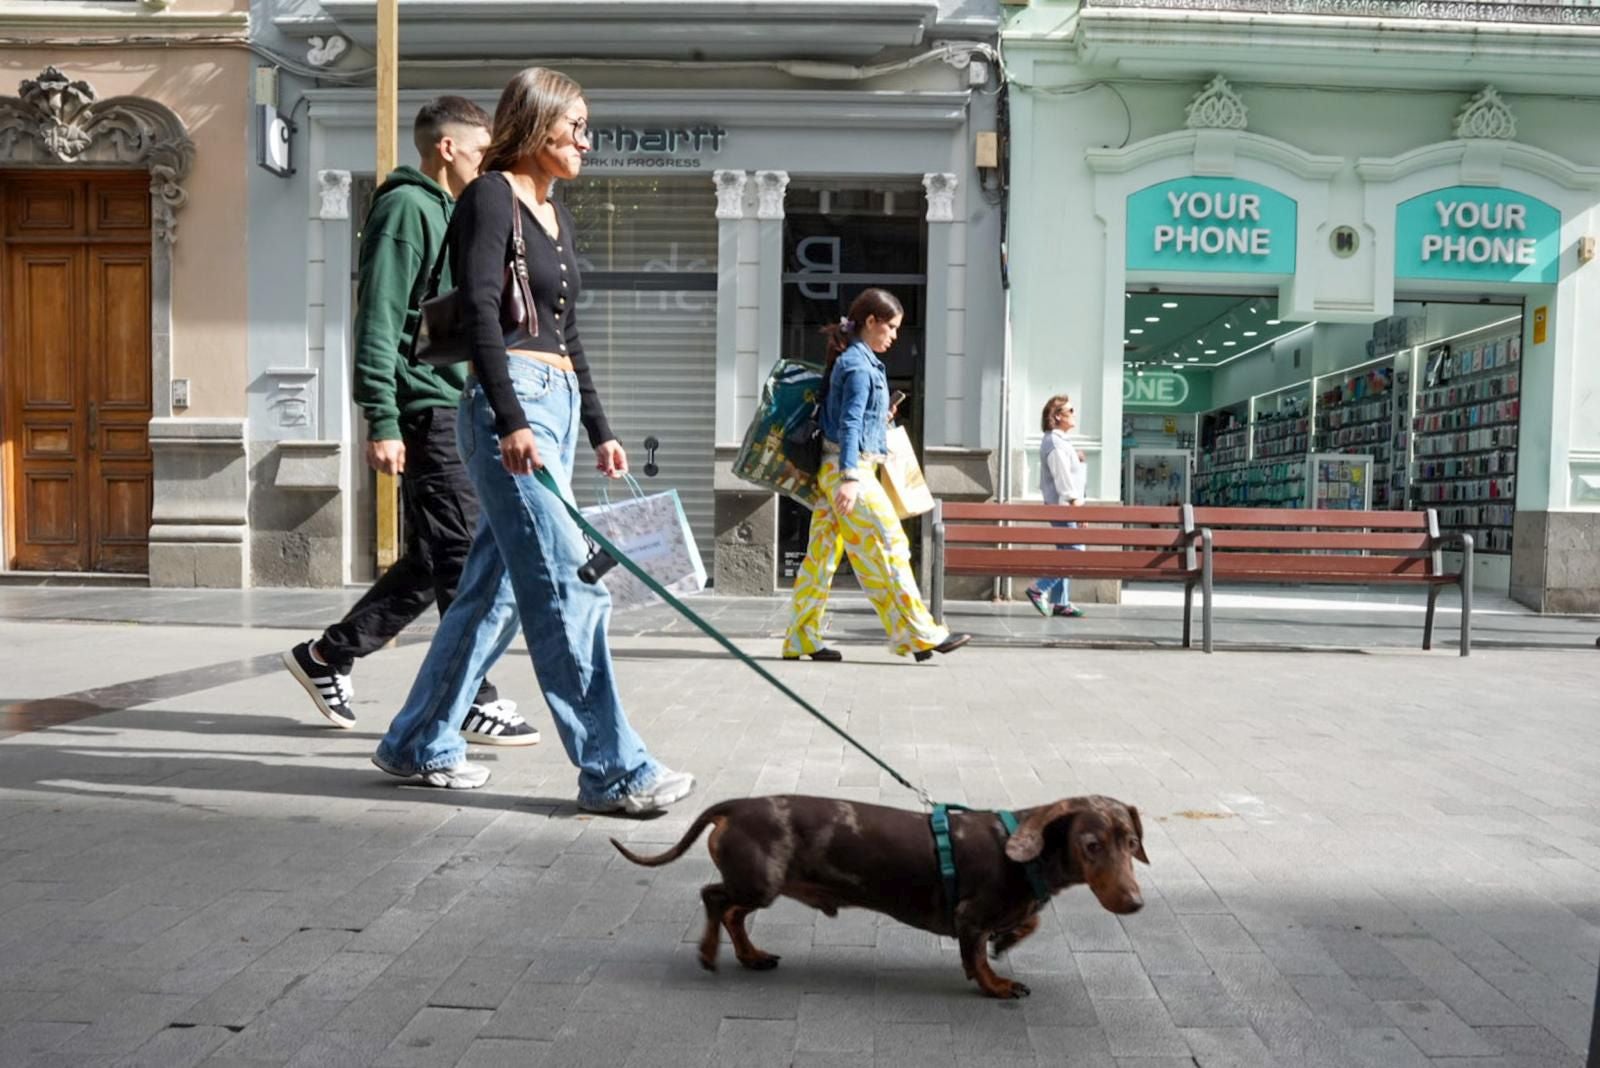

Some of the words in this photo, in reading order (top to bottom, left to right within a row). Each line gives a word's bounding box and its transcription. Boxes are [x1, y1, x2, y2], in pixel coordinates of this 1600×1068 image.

[591, 125, 726, 152] rhartt
[581, 158, 608, 167] ORK
[611, 158, 624, 167] IN
[627, 158, 700, 168] PROGRESS
[1167, 191, 1260, 220] YOUR
[1435, 200, 1526, 230] YOUR
[1154, 225, 1271, 254] PHONE
[1421, 234, 1537, 265] PHONE
[1123, 378, 1175, 401] ONE
